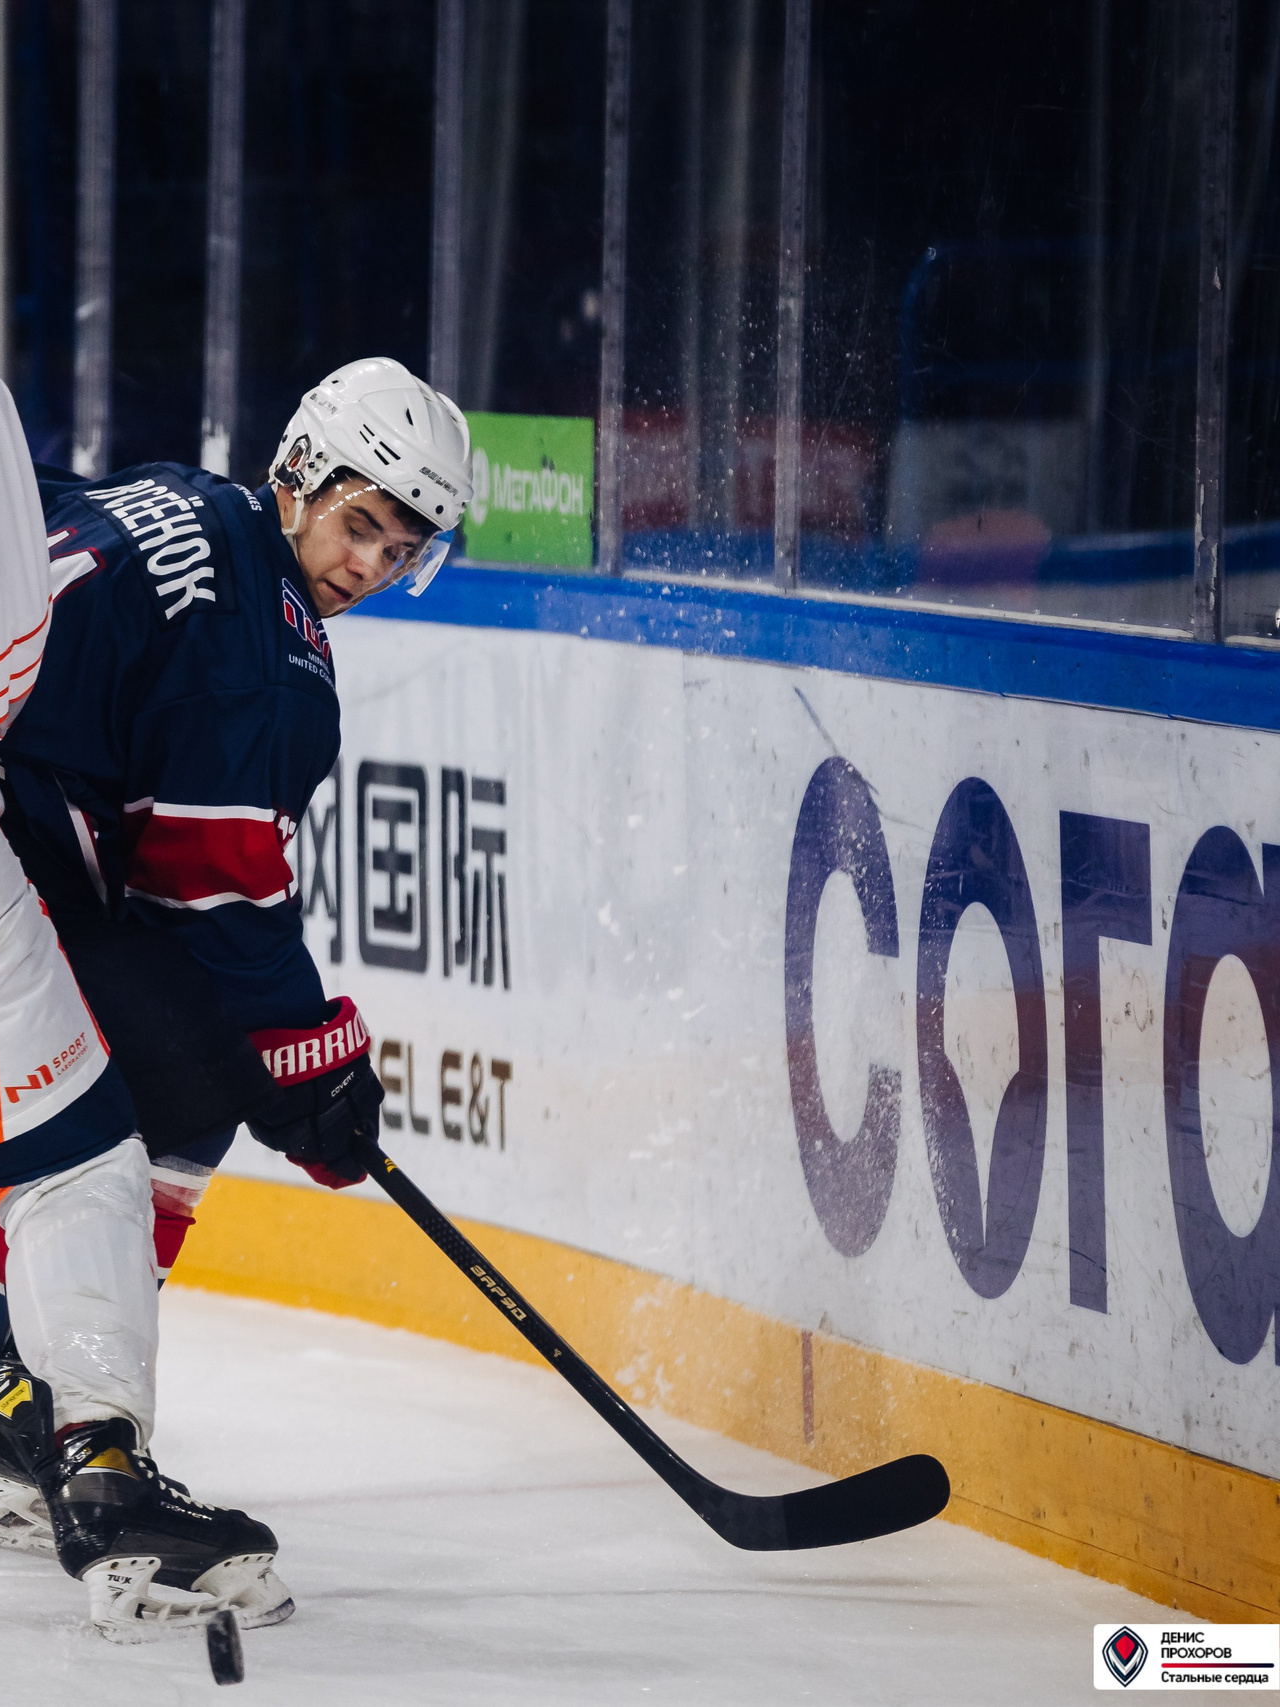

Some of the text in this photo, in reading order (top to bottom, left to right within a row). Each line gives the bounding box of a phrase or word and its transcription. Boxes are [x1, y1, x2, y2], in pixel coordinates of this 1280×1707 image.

[288, 653, 318, 674] UNITED
[52, 1031, 86, 1069] SPORT
[330, 1071, 355, 1098] COVERT
[440, 1049, 513, 1152] E&T
